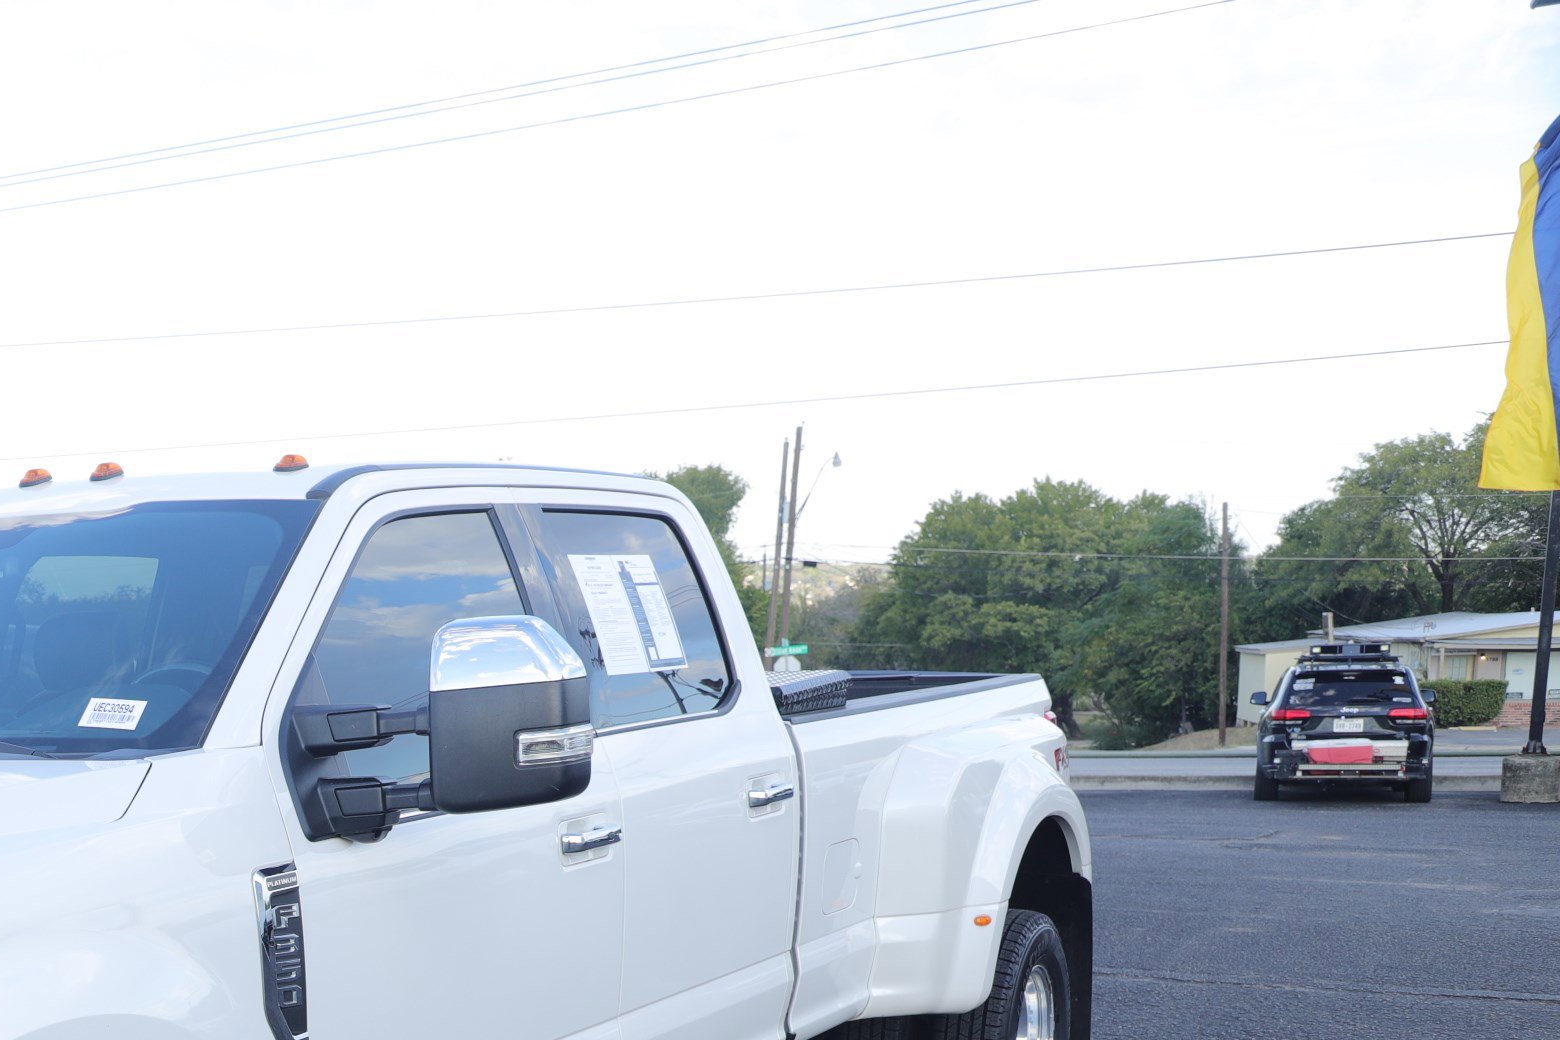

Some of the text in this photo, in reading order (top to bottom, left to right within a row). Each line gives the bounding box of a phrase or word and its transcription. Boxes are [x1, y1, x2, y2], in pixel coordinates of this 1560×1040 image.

[92, 702, 136, 714] UEC30594
[1339, 706, 1360, 714] Jeep
[267, 875, 298, 888] PLATINUM
